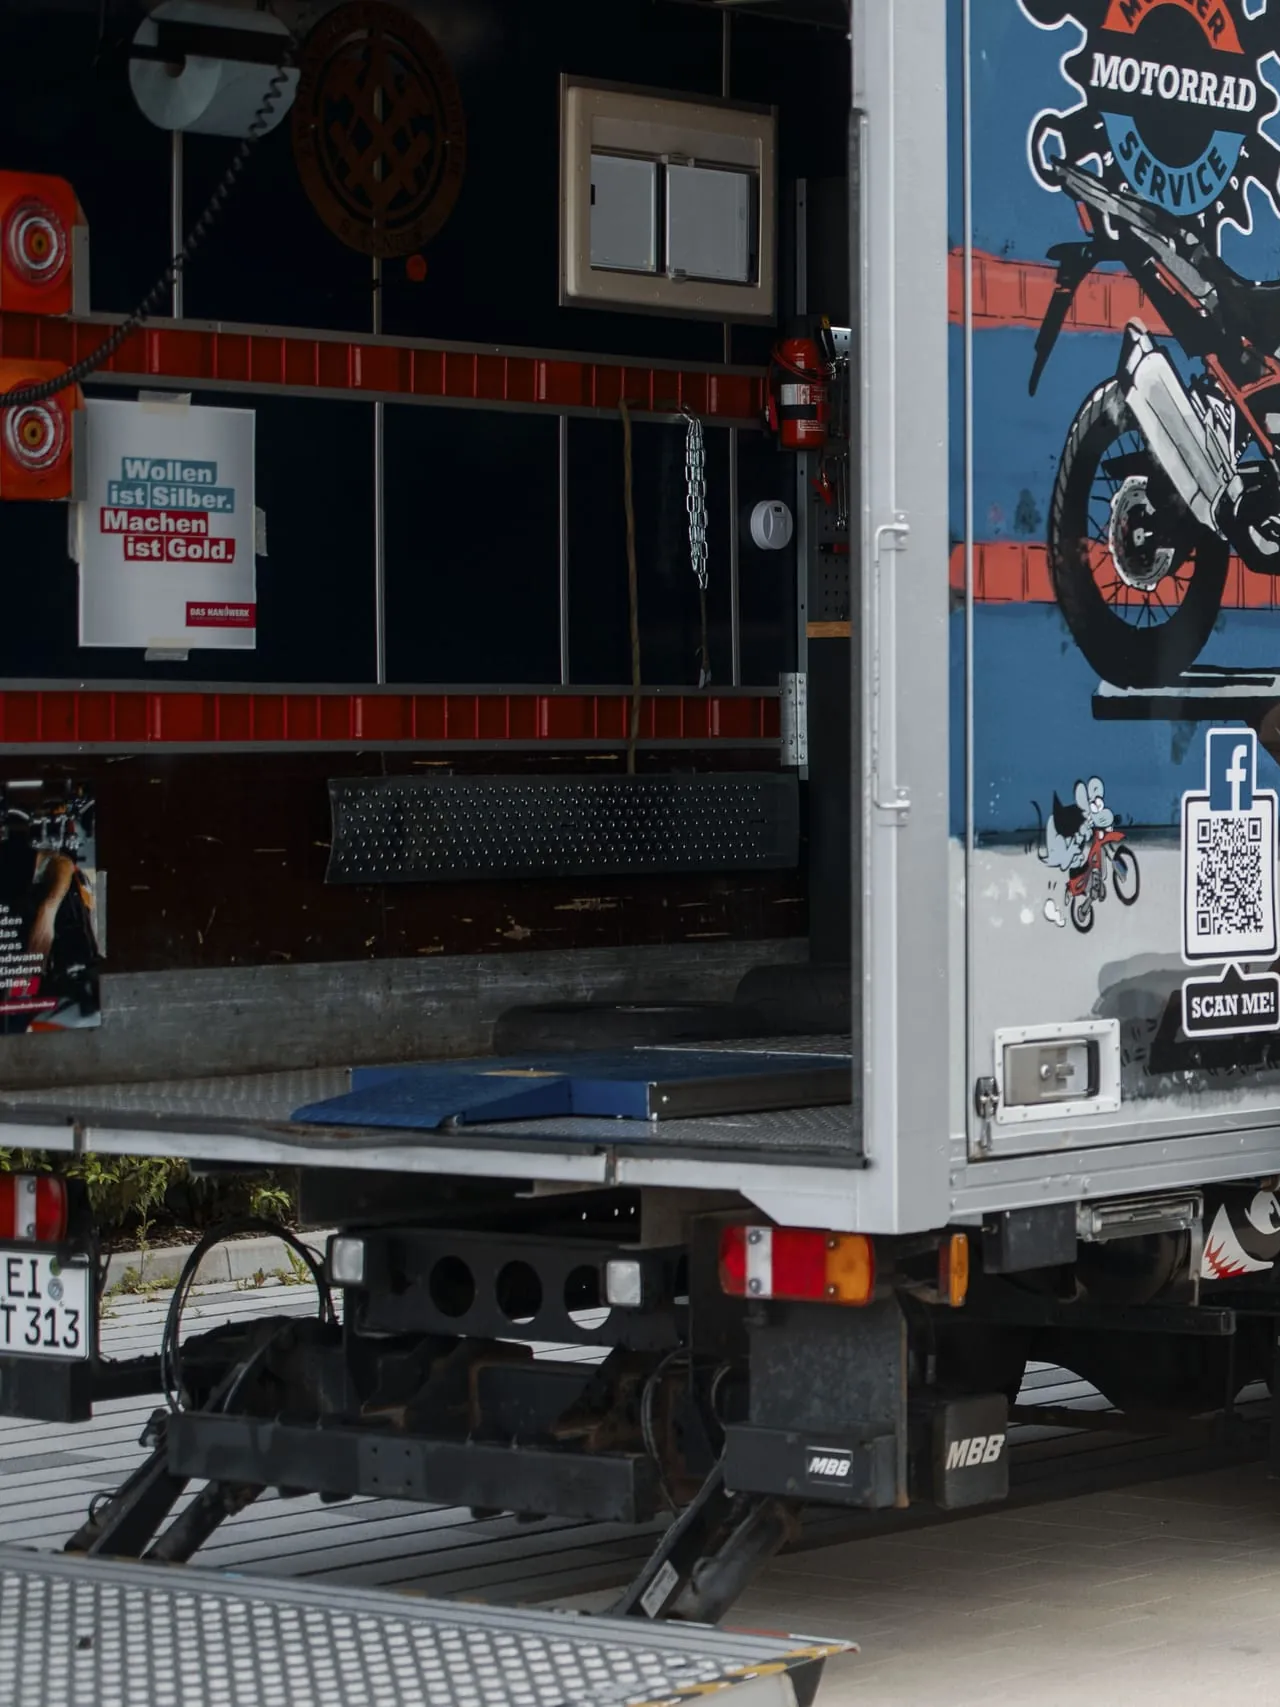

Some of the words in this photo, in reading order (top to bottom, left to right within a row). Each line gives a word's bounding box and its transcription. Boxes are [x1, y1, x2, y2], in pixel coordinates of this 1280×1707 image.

[1090, 52, 1257, 112] MOTORRAD
[1118, 130, 1228, 207] SERVICE
[125, 459, 213, 483] Wollen
[111, 485, 145, 506] ist
[152, 486, 232, 510] Silber.
[103, 510, 207, 534] Machen
[126, 538, 161, 558] ist
[167, 539, 233, 560] Gold.
[189, 606, 206, 617] DAS
[1191, 994, 1239, 1018] SCAN
[1241, 991, 1275, 1015] ME!
[7, 1257, 42, 1300] EI
[25, 1305, 80, 1349] 313
[946, 1434, 1006, 1471] MBB
[808, 1456, 851, 1477] MBB
